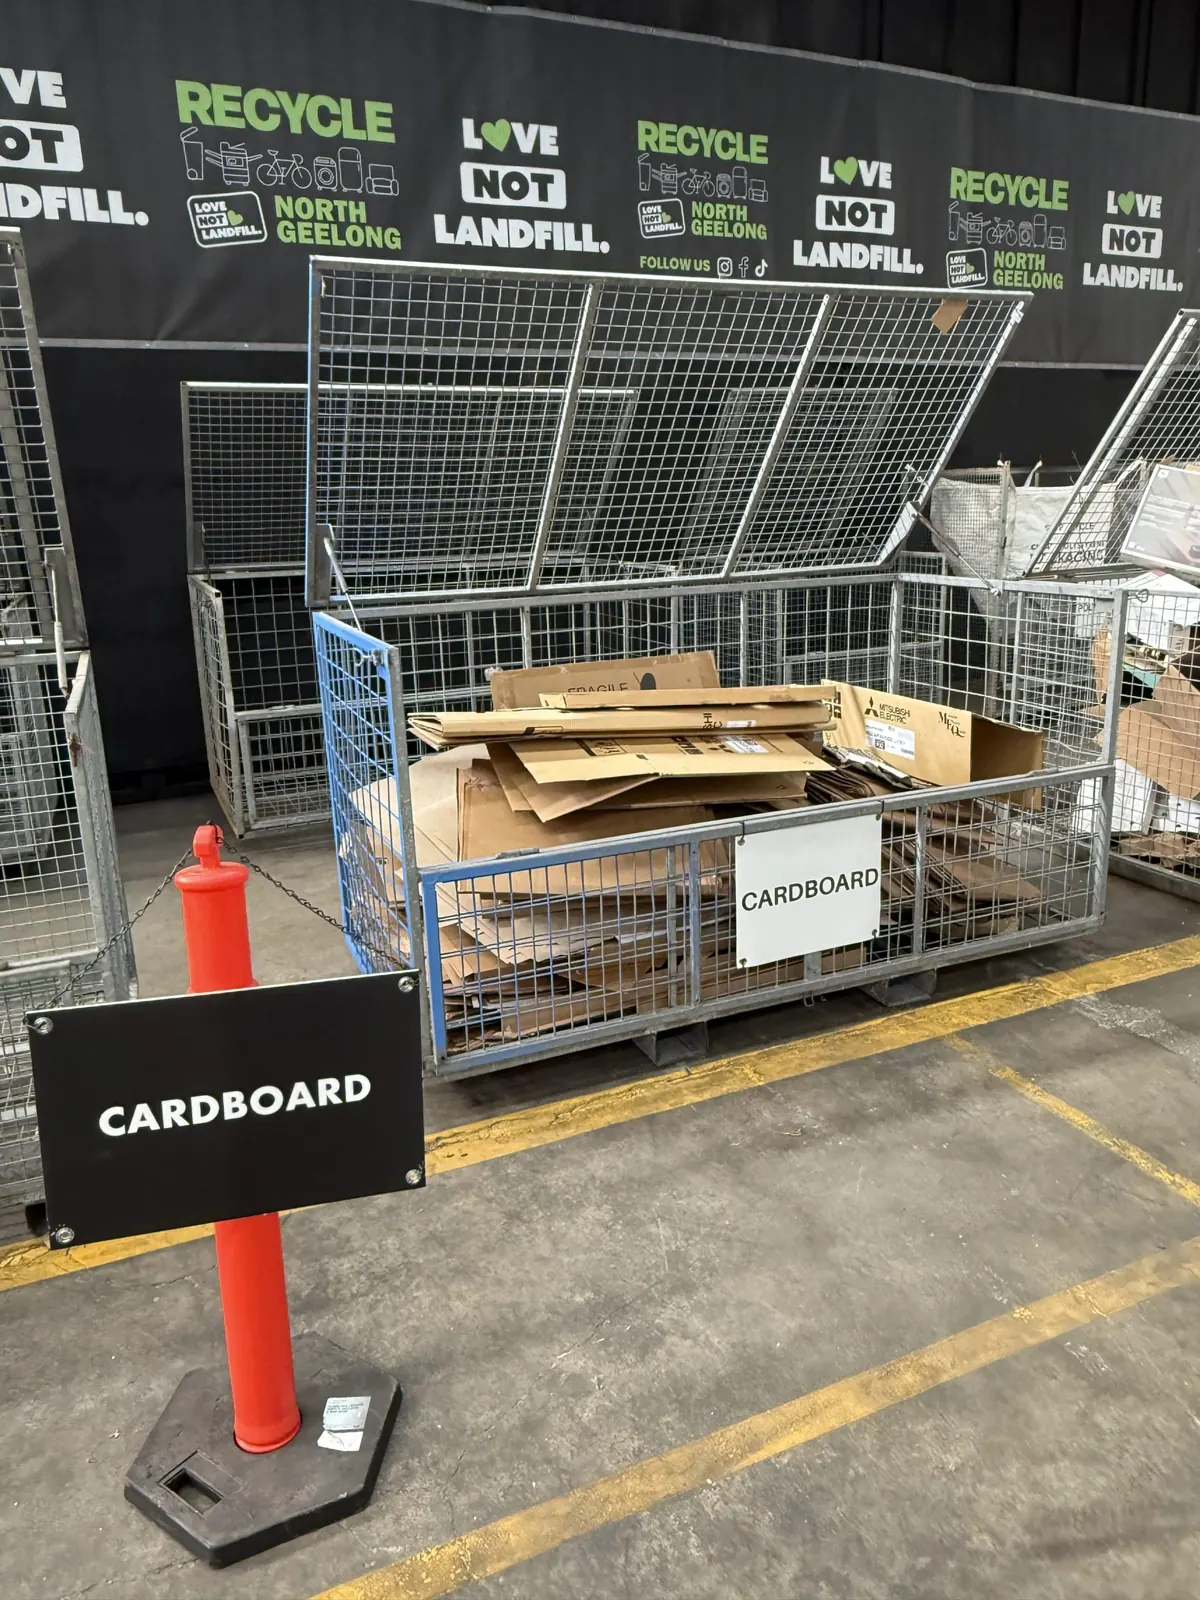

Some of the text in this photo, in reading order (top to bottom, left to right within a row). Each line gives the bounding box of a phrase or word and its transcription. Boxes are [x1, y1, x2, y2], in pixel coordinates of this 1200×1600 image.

[0, 67, 68, 109] VE
[175, 79, 396, 143] RECYCLE
[0, 125, 64, 164] OT
[637, 120, 769, 165] RECYCLE
[473, 168, 555, 203] NOT
[949, 167, 1069, 211] RECYCLE
[0, 182, 149, 227] DFILL.
[194, 201, 227, 213] LOVE
[274, 195, 367, 224] NORTH
[642, 205, 662, 214] LOVE
[691, 201, 748, 221] NORTH
[825, 200, 888, 229] NOT
[198, 215, 224, 226] NOT
[201, 225, 262, 240] LANDFILL.
[276, 220, 401, 249] GEELONG
[433, 213, 611, 254] LANDFILL.
[691, 219, 768, 240] GEELONG
[1108, 229, 1157, 254] NOT
[639, 255, 711, 272] FOLLOW US
[793, 239, 924, 275] LANDFILL.
[993, 250, 1045, 271] NORTH
[993, 267, 1064, 290] GEELONG
[1082, 262, 1184, 292] LANDFILL.
[741, 868, 879, 911] CARDBOARD
[98, 1073, 372, 1137] CARDBOARD
